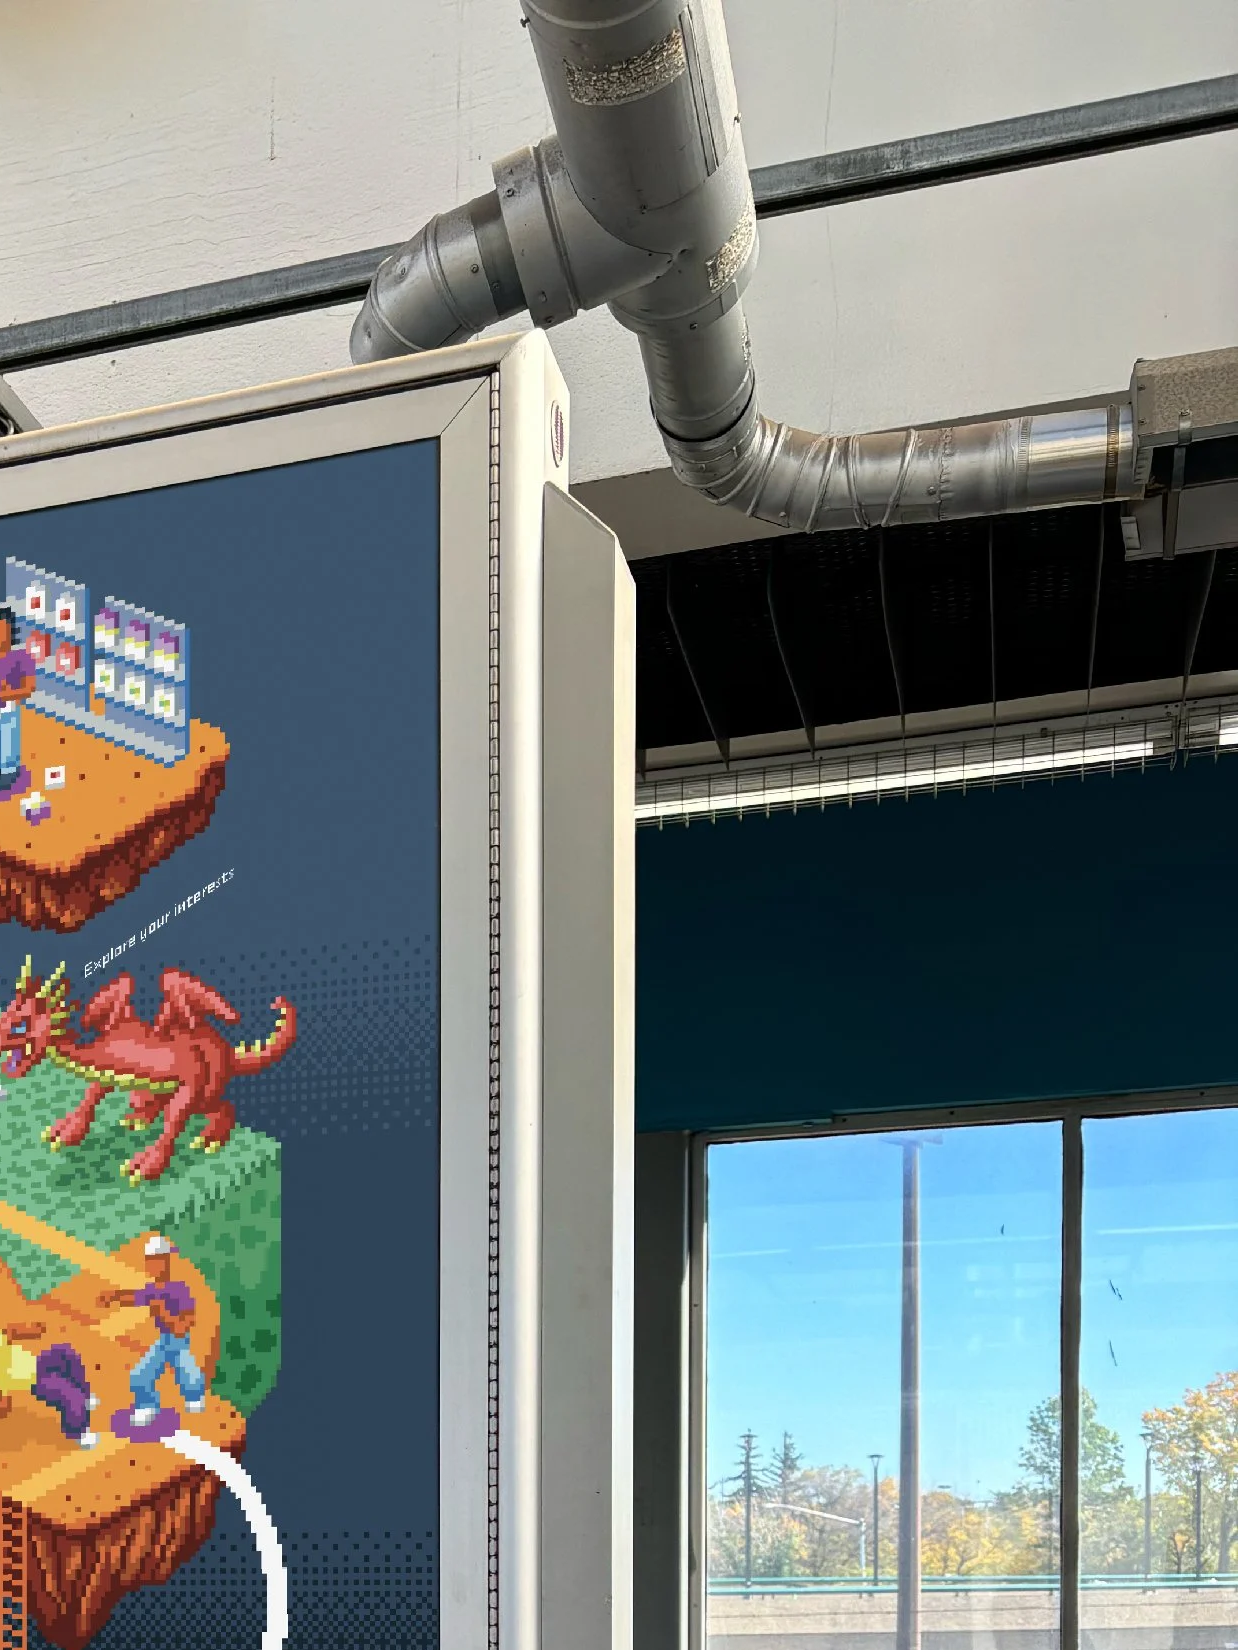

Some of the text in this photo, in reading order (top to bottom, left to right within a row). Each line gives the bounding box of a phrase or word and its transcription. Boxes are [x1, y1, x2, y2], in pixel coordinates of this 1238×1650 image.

[84, 867, 235, 979] Explore your interests
